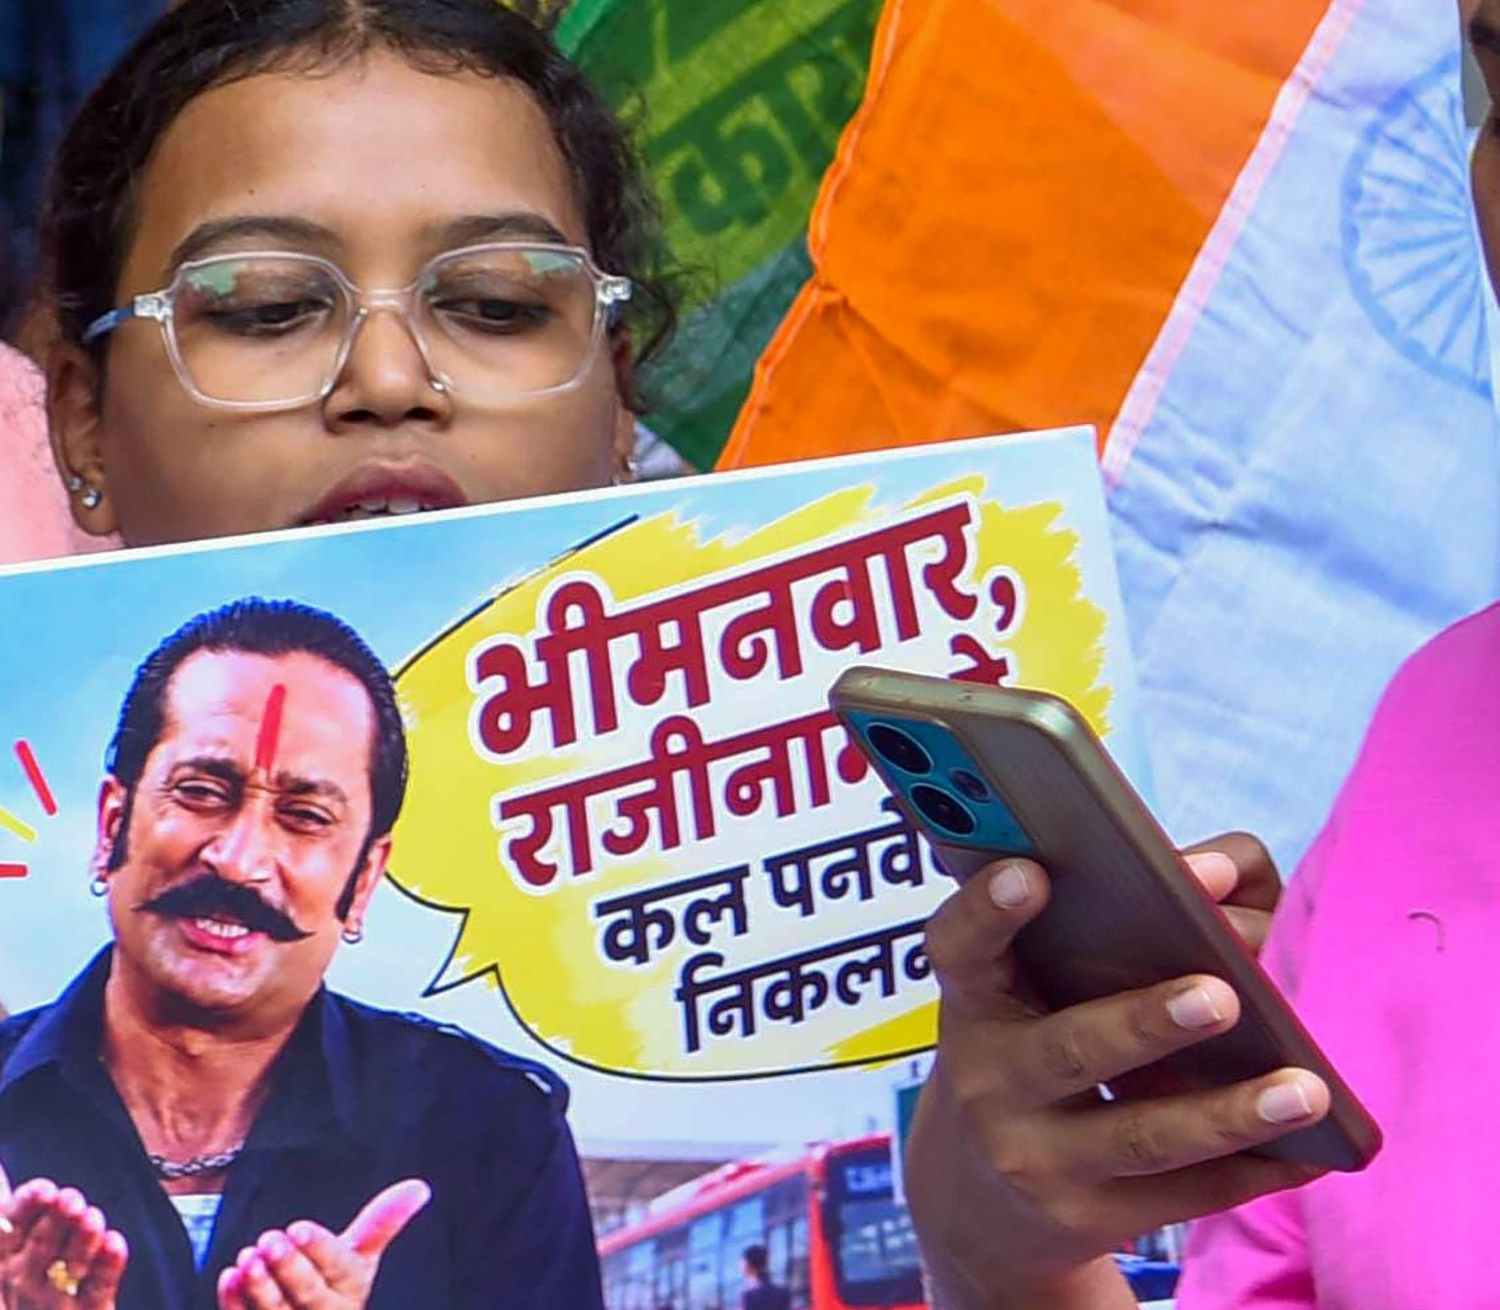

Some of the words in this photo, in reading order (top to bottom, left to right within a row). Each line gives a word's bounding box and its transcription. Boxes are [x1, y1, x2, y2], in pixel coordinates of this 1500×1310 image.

[478, 503, 1016, 754] भीमनवार,
[502, 712, 868, 884] राजीना
[598, 862, 750, 966] कल
[676, 914, 936, 1052] निकल
